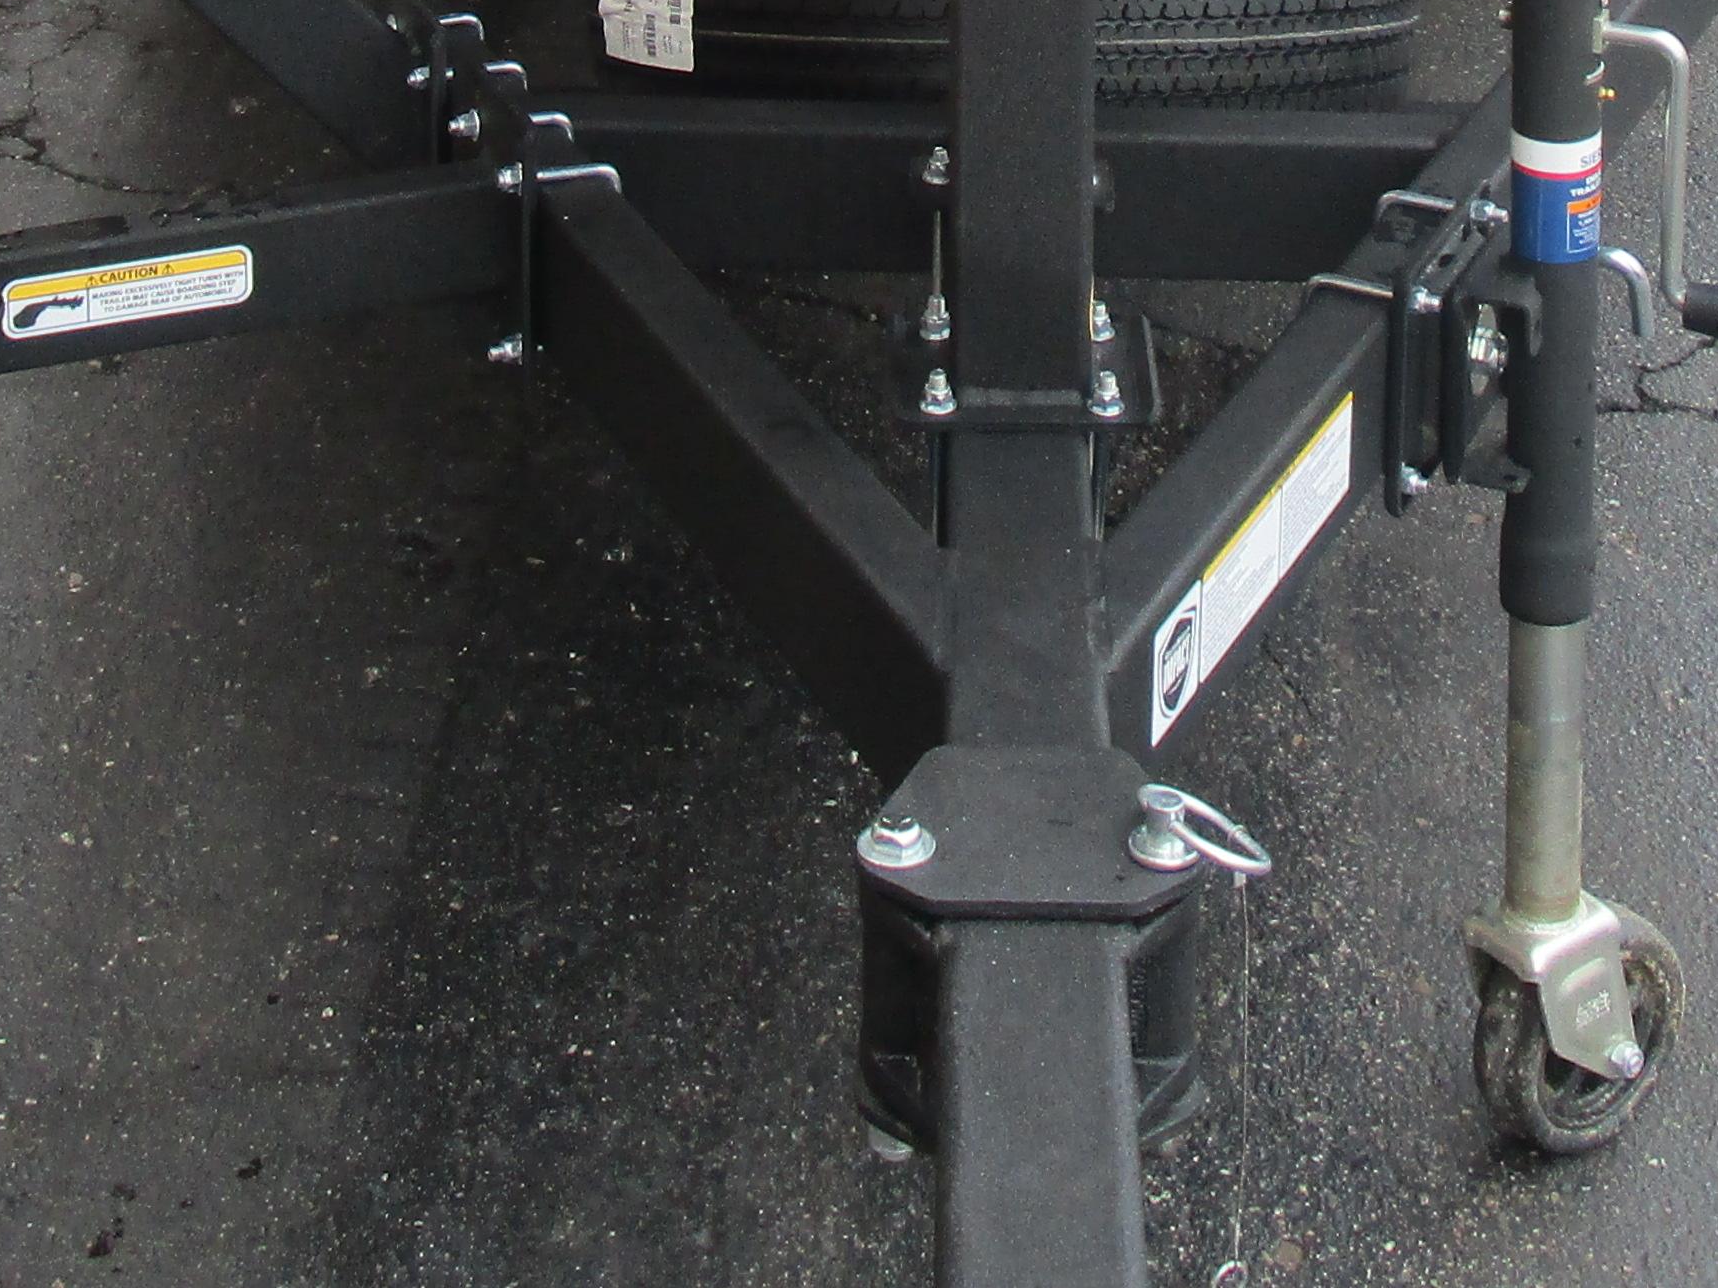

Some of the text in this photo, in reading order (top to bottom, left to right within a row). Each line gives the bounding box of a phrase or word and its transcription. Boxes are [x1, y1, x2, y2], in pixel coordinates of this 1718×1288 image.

[92, 288, 123, 299] MAKING
[125, 281, 172, 294] EXCESSIVELY
[198, 273, 222, 282] TURNS
[224, 270, 243, 278] WITH
[99, 265, 158, 284] CAUTION
[100, 278, 236, 306] TRAILER MAY CAUSE BOARDING STEP
[116, 300, 148, 311] DAMAGE
[151, 297, 171, 305] REAR
[172, 294, 182, 302] OF
[184, 287, 233, 300] AUTOMOBILE
